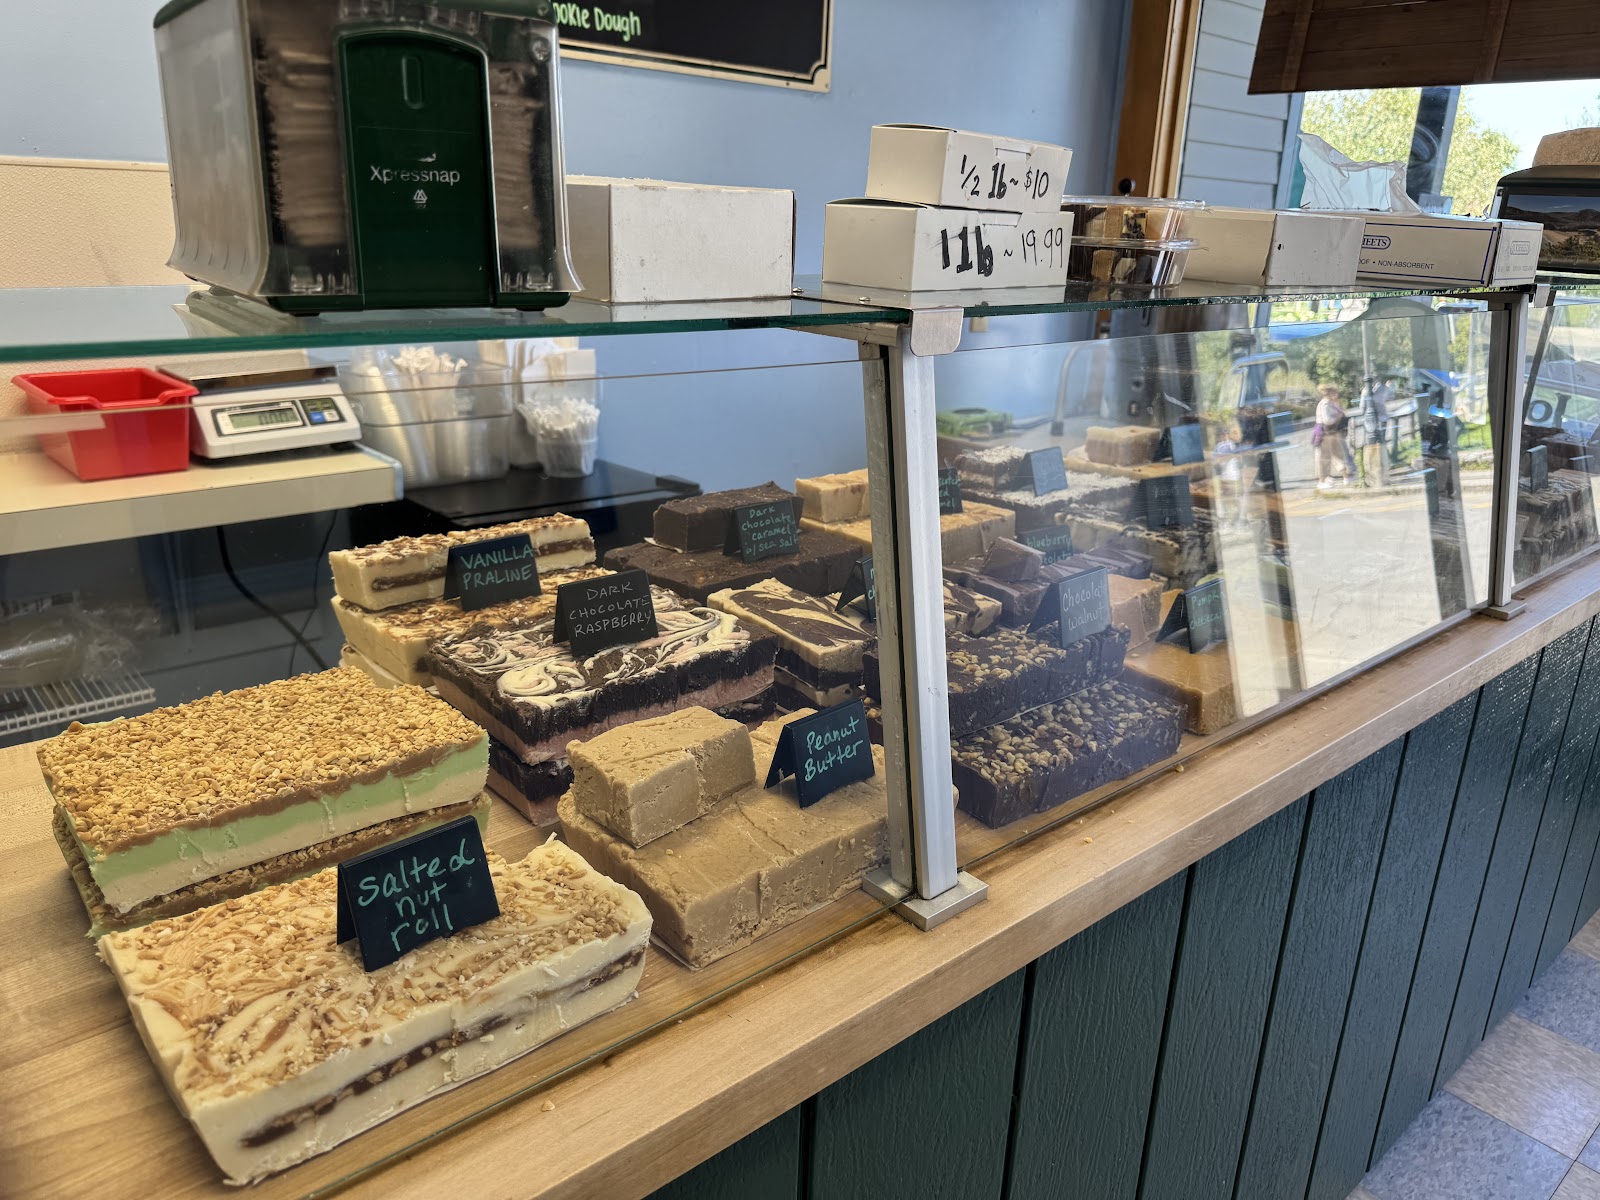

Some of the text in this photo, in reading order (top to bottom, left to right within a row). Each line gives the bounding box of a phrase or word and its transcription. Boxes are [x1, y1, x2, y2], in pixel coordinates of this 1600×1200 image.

[553, 3, 641, 42] ookie Dough
[370, 165, 460, 186] Xpressnap
[1023, 166, 1049, 199] $10
[1021, 227, 1063, 268] 19.99
[1377, 260, 1435, 270] NON-ABSORBENT
[749, 506, 776, 519] Dark
[751, 524, 792, 541] caramel
[758, 541, 777, 552] sea
[779, 533, 799, 548] salt
[461, 543, 534, 570] VANILLA
[463, 563, 533, 591] PRALINE
[586, 581, 634, 601] DARK
[569, 594, 651, 620] CHOCOLATE
[1062, 580, 1104, 612] Chocolat
[574, 610, 652, 638] RASPBERRY
[1068, 602, 1105, 631] walnut
[806, 715, 860, 755] Peanut
[804, 739, 864, 782] Butter
[395, 881, 448, 917] nut
[391, 903, 454, 952] roll
